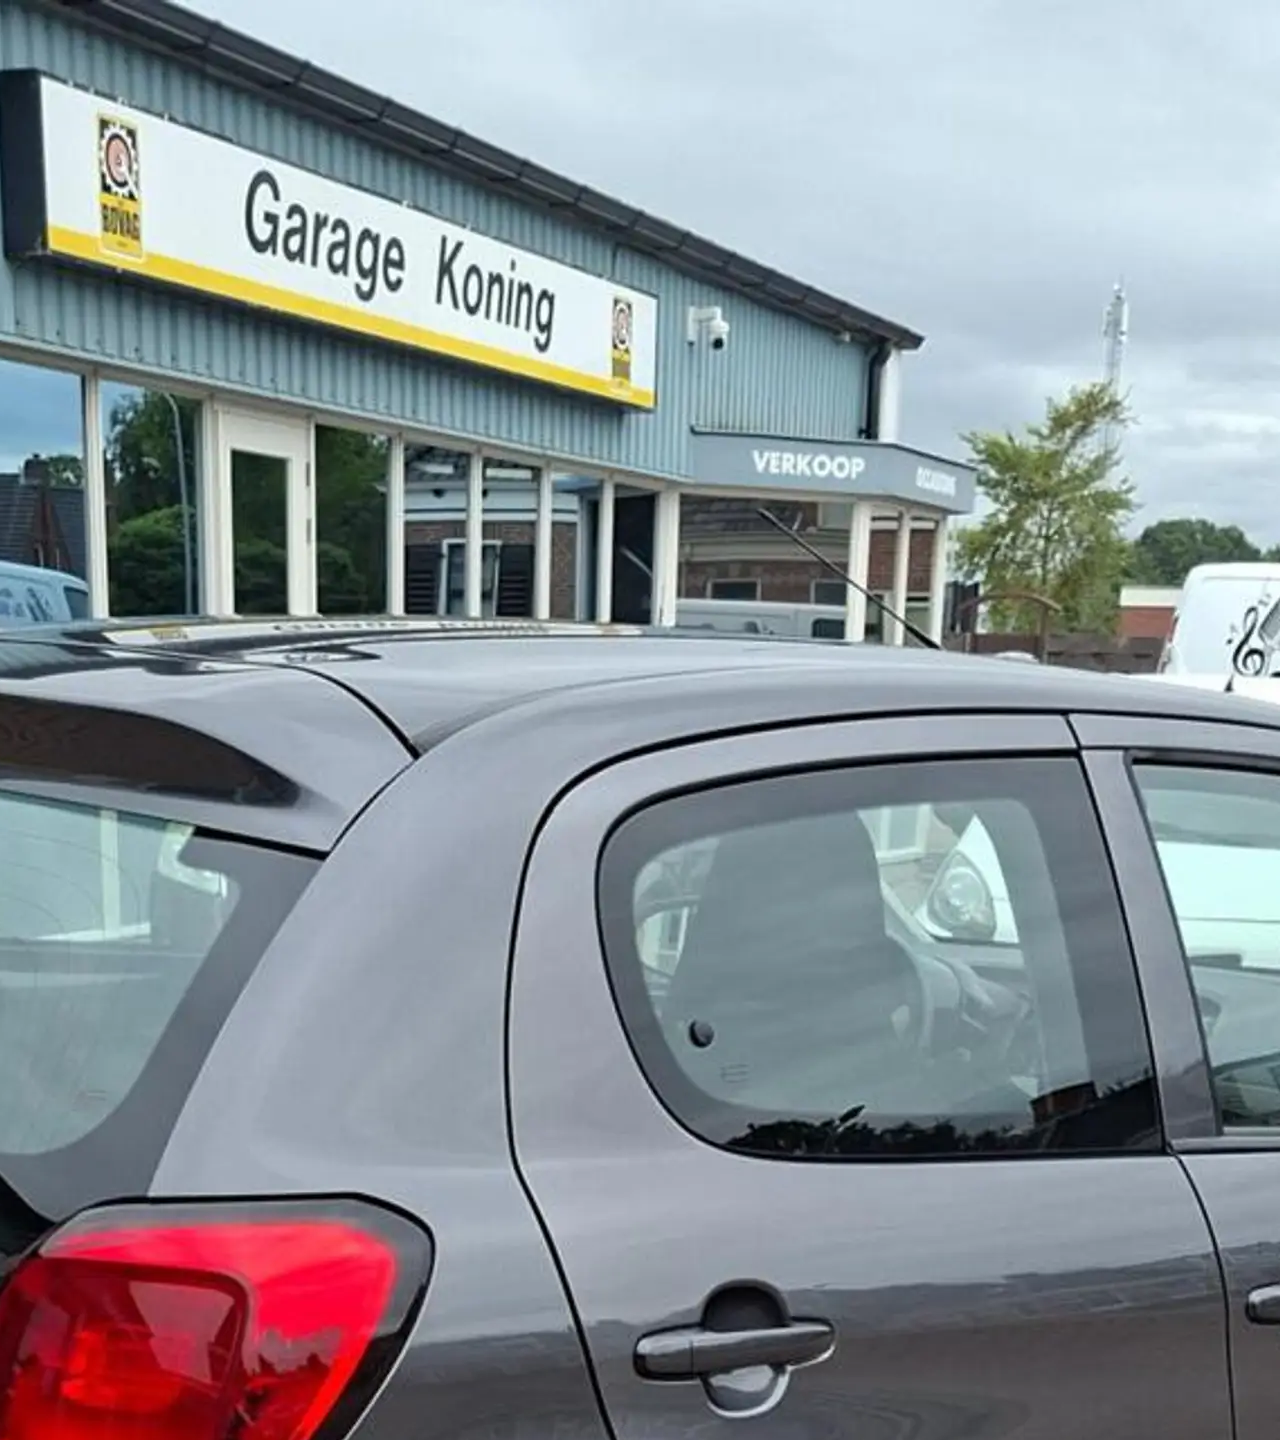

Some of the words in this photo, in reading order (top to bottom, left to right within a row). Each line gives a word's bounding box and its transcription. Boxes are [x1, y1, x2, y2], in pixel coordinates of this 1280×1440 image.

[245, 169, 406, 301] Garage
[436, 235, 555, 352] Koning
[753, 450, 866, 480] VERKOOP
